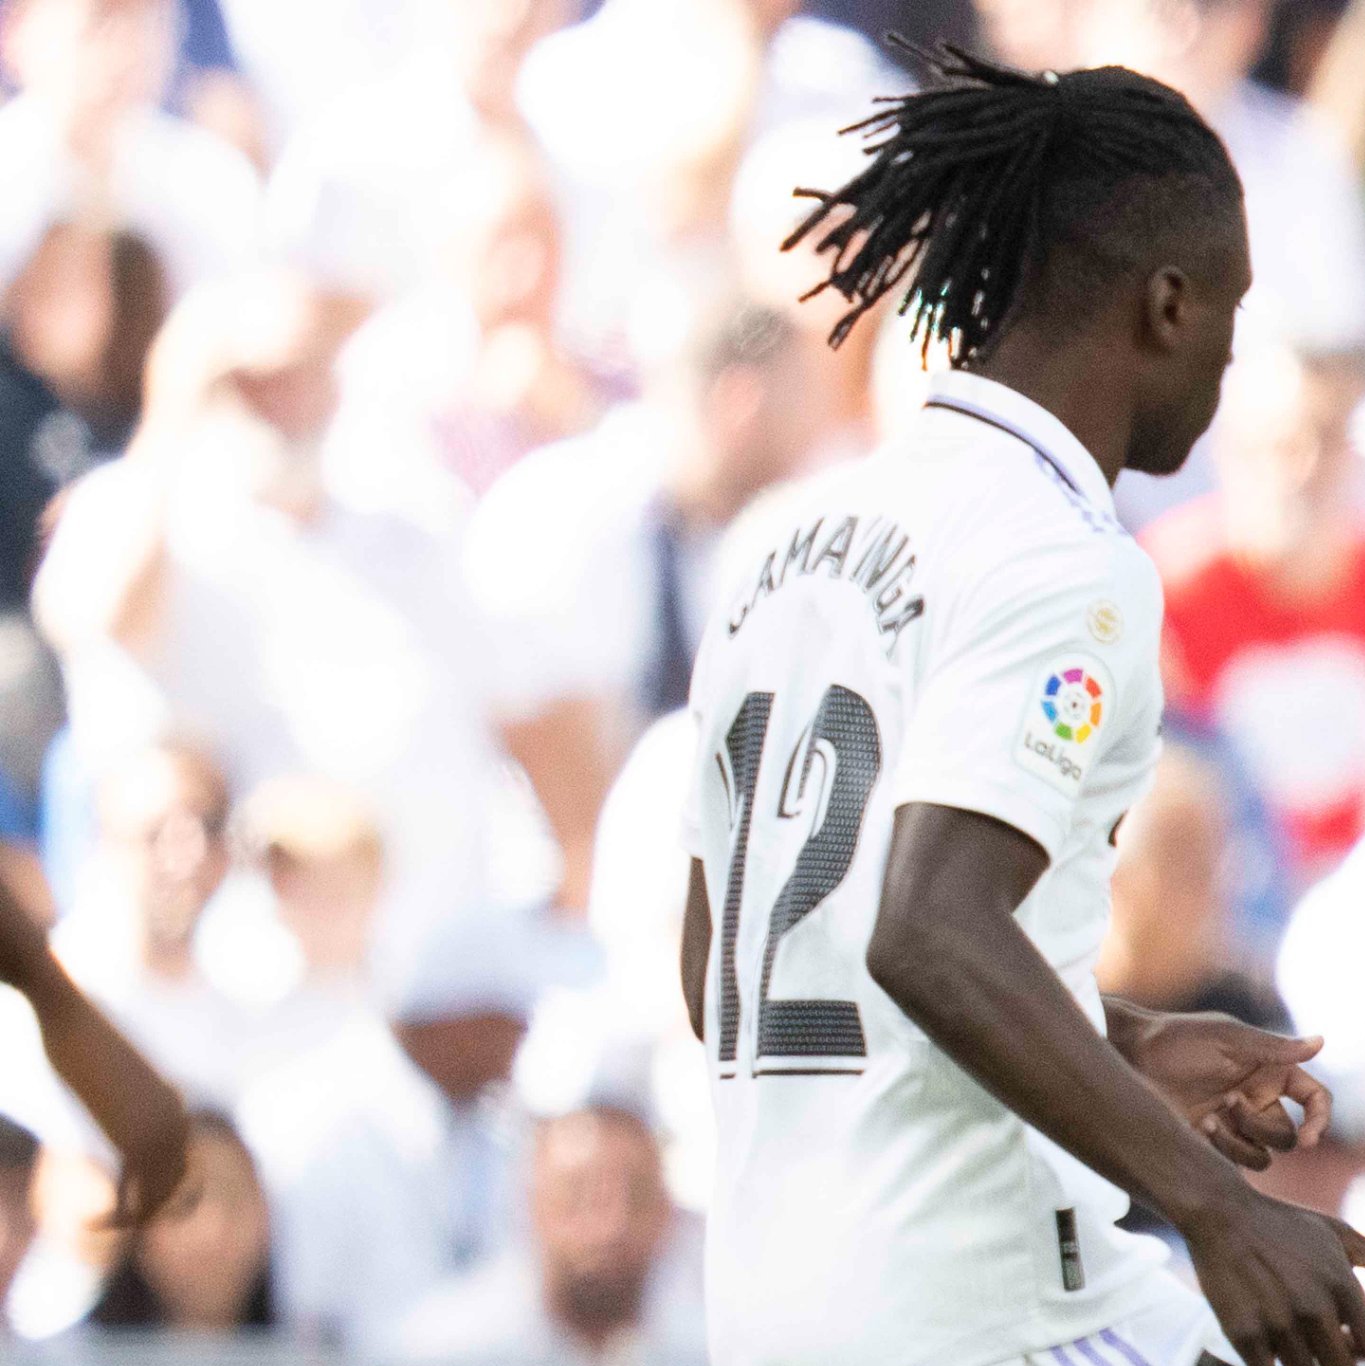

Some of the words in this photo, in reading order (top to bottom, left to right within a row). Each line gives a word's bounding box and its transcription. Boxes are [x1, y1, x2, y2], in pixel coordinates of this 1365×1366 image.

[728, 515, 924, 664] CAMAINGA
[1024, 731, 1082, 782] LaLiga
[716, 684, 883, 1079] 12
